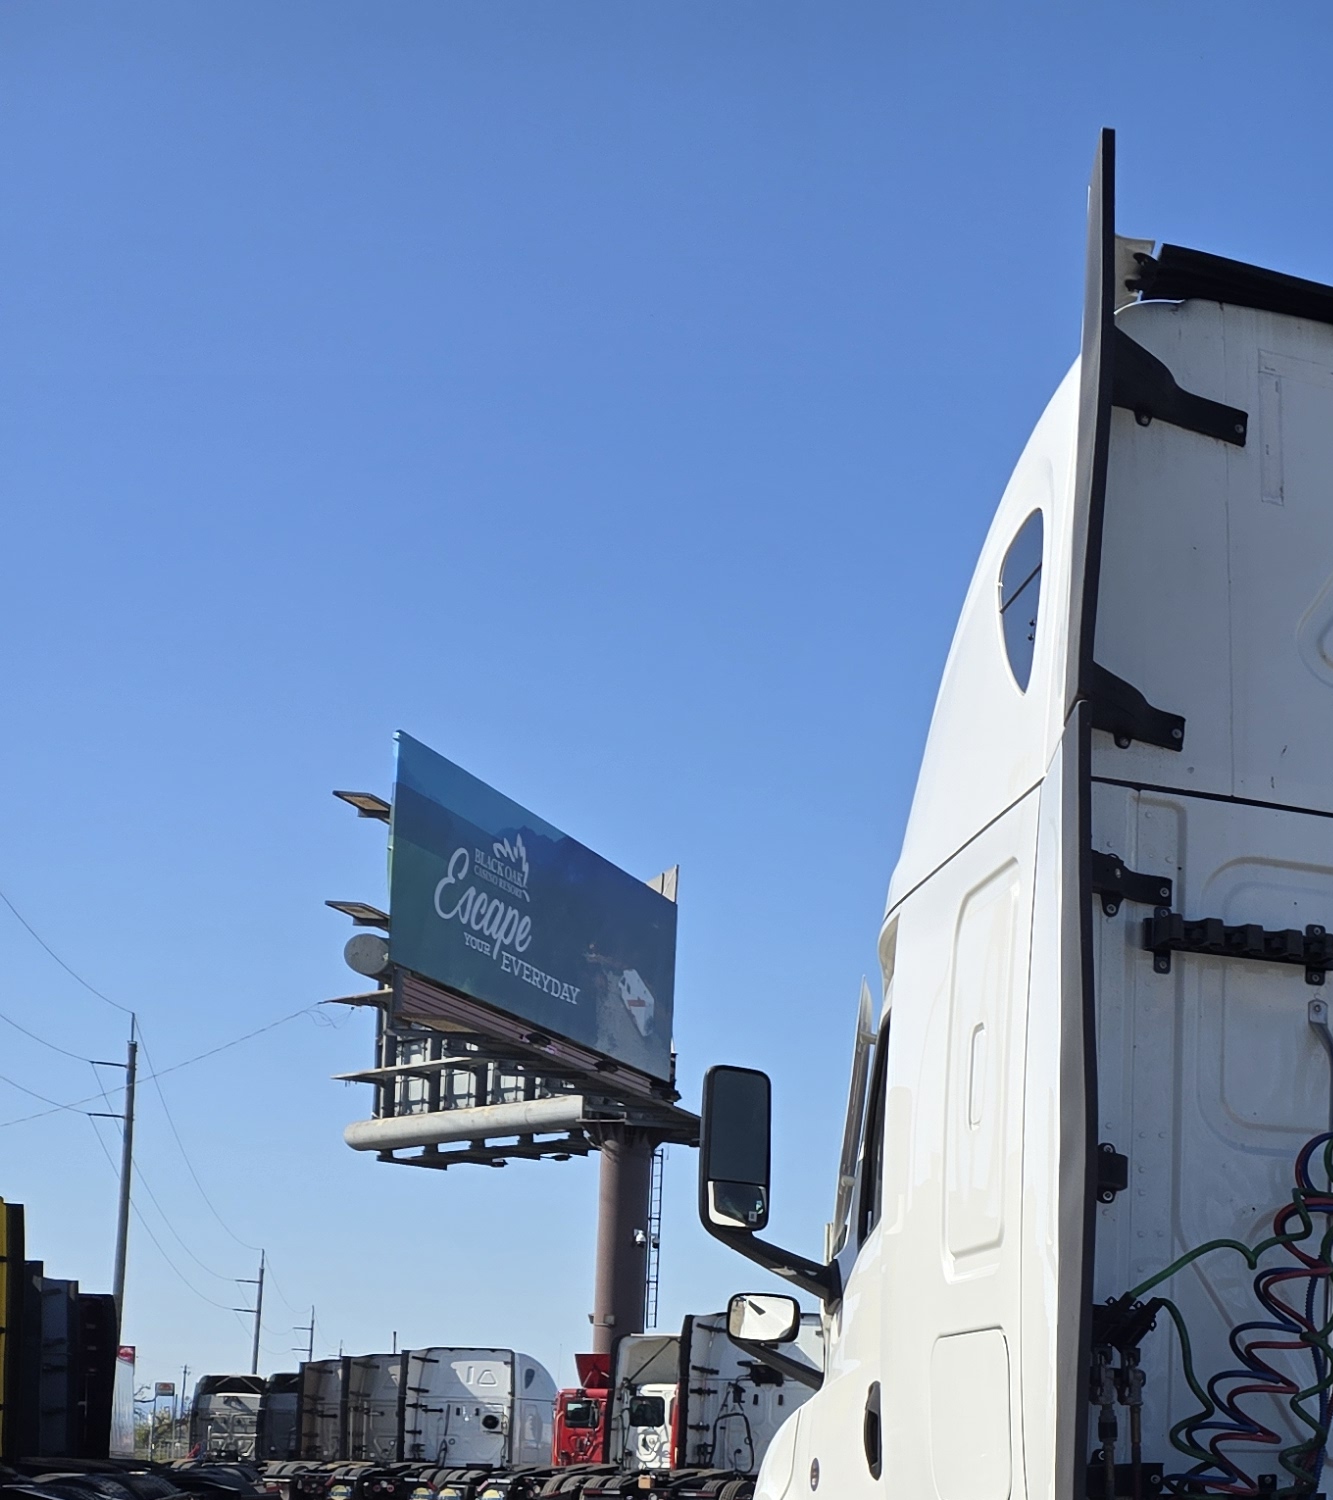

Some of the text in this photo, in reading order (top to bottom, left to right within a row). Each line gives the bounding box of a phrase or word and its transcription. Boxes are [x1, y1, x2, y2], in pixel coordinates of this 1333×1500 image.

[474, 848, 524, 887] BLACK OAK
[474, 865, 524, 899] CASINO RESORT
[434, 847, 532, 960] Escape
[463, 932, 491, 956] YOUR
[500, 951, 581, 1005] EVERYDAY
